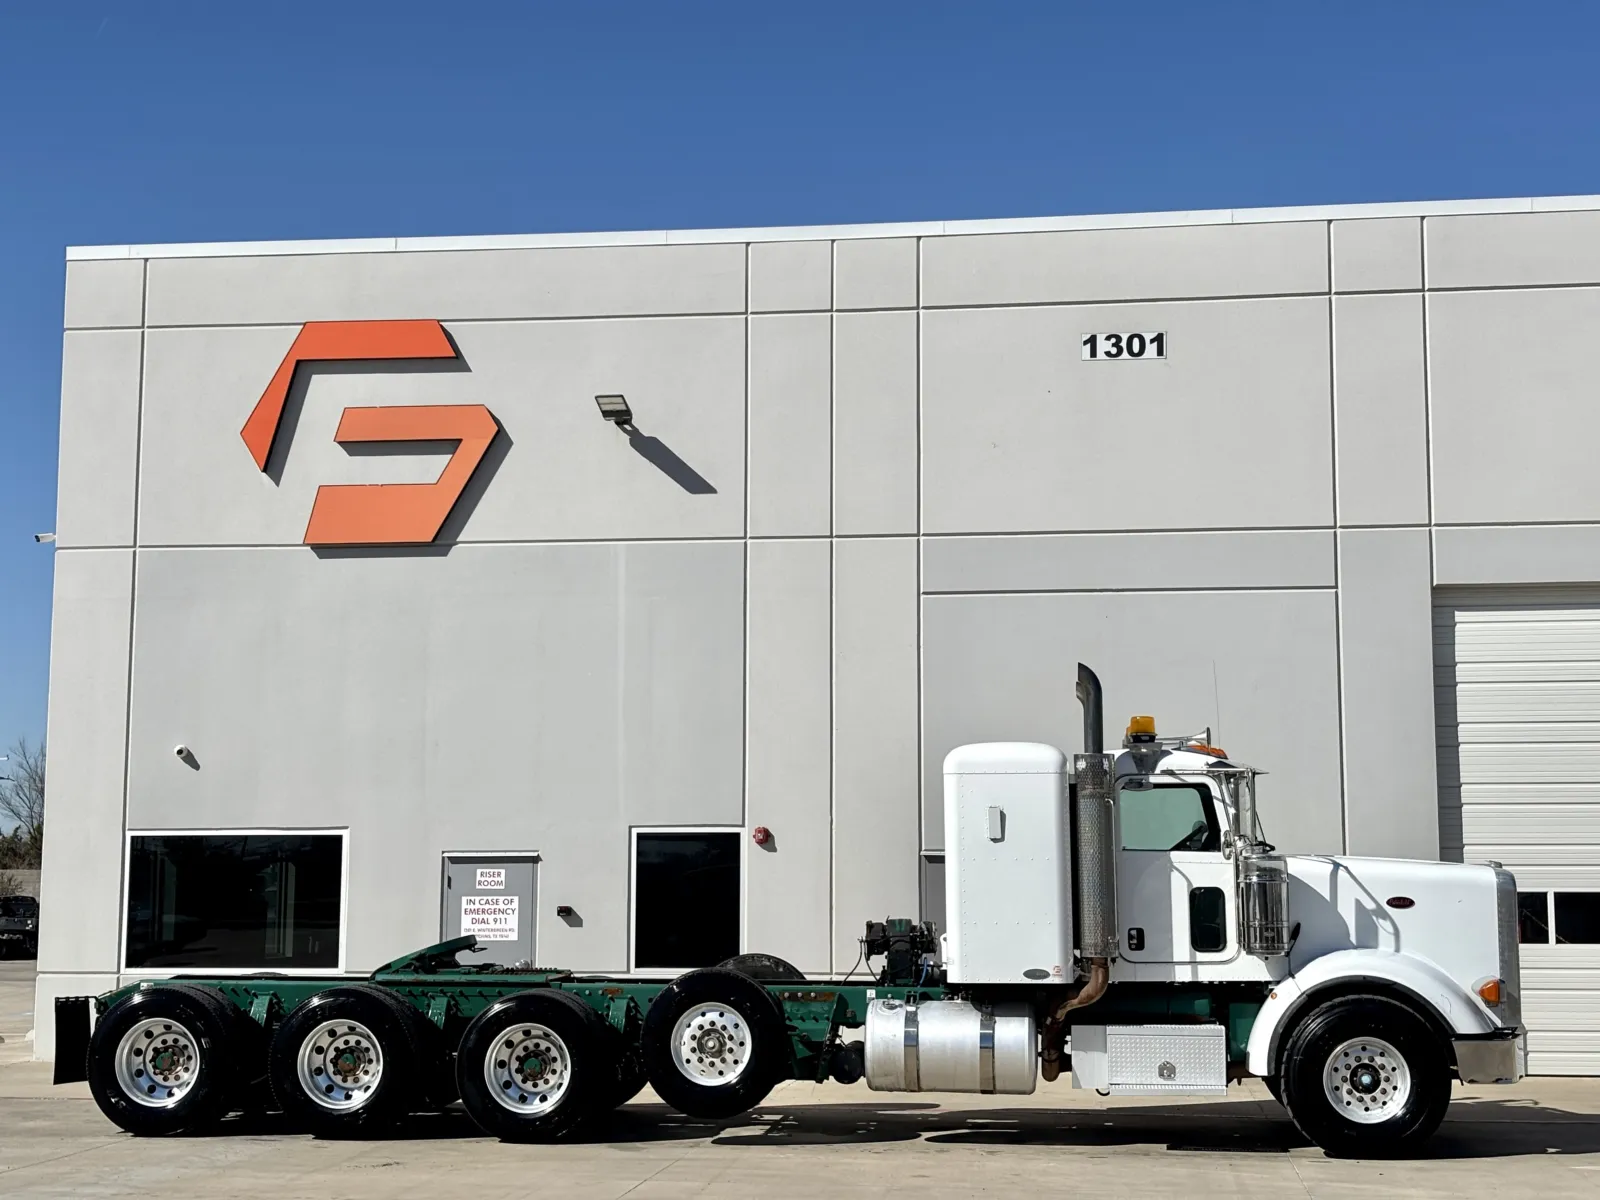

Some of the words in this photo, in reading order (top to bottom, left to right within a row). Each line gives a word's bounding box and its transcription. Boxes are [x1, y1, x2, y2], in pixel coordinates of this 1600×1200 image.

[1083, 332, 1164, 358] 1301
[466, 898, 476, 906] IN
[478, 898, 500, 906] CASE
[502, 898, 515, 906] OF
[464, 908, 517, 916] EMERGENCY
